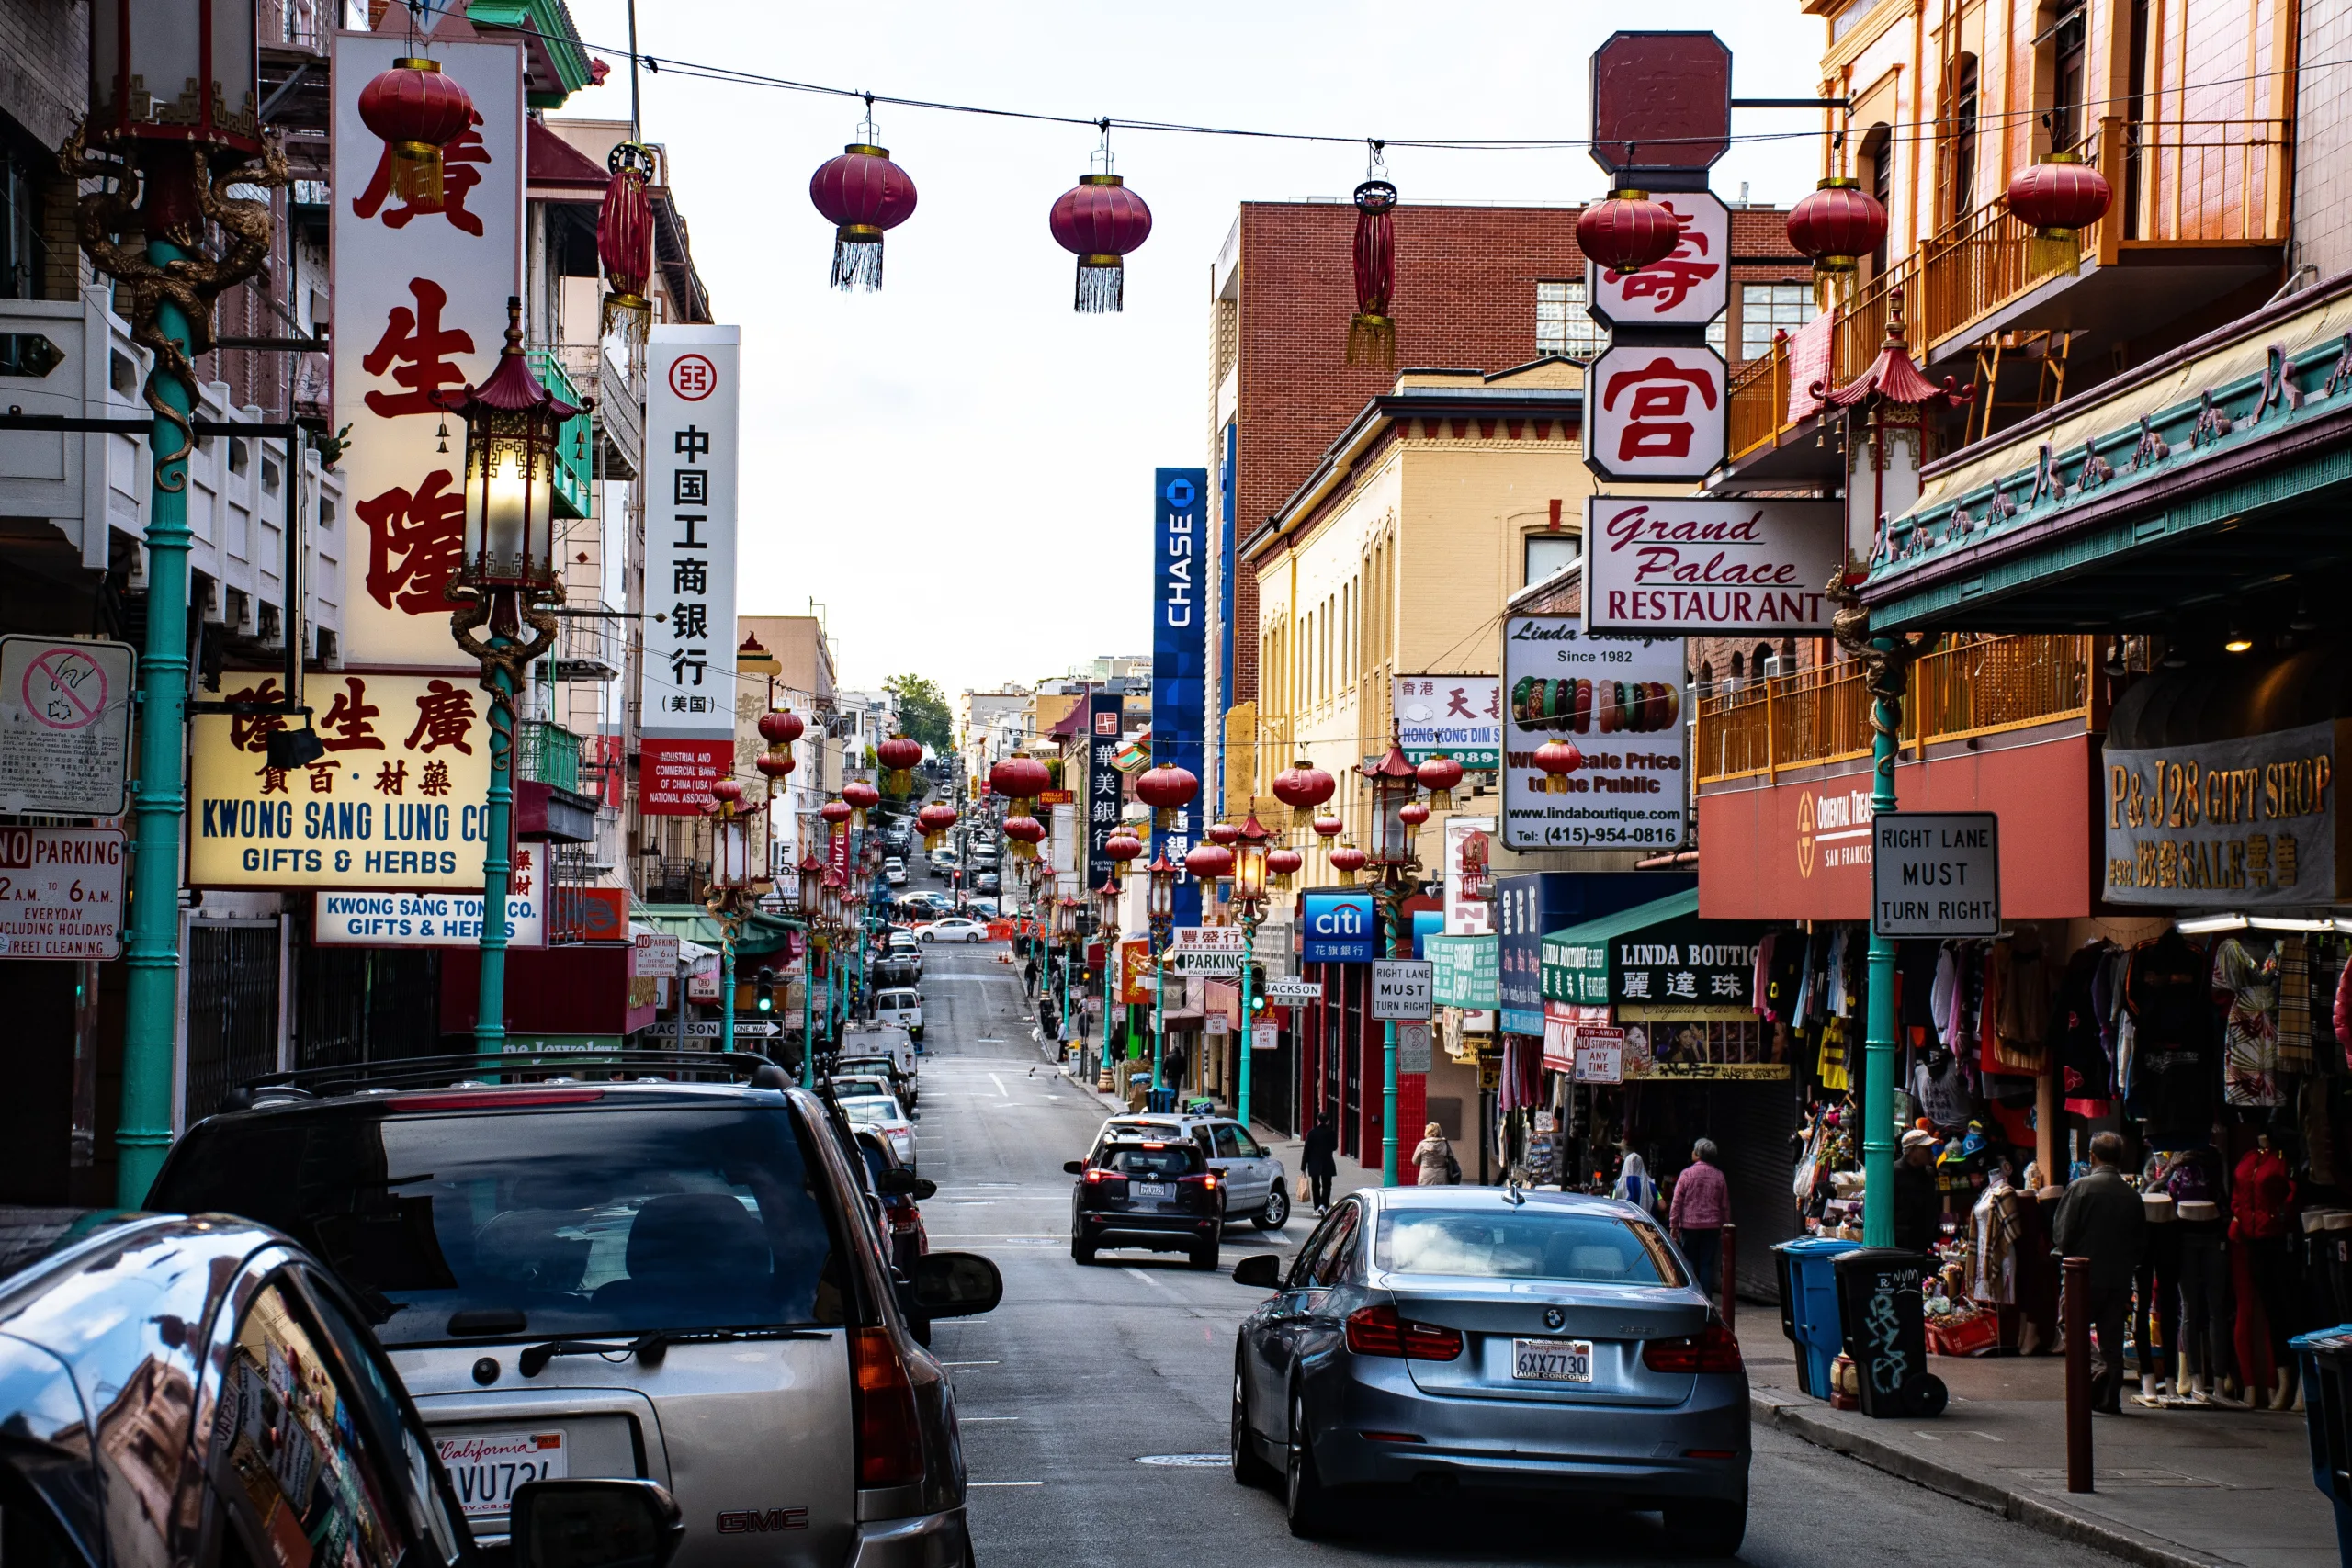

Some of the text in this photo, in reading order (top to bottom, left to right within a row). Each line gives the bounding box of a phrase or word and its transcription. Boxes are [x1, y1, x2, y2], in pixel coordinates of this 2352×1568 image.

[1607, 505, 1763, 552] Grand
[672, 424, 709, 686] 中国工商银行
[1168, 513, 1192, 626] CHASE
[1634, 547, 1796, 583] Palace
[1609, 591, 1826, 623] RESTAURANT
[1557, 650, 1632, 662] Since 1982
[1402, 682, 1433, 695] 香港
[1403, 728, 1490, 743] HONG KONG DIM
[660, 752, 711, 763] INDUSTRIAL AND
[1625, 753, 1681, 770] Price
[656, 765, 716, 776] COMMERCIAL BANK
[661, 780, 669, 788] OF
[673, 780, 692, 789] CHINA
[1593, 776, 1660, 794] Public
[2205, 768, 2259, 825] GIFT
[2266, 754, 2331, 819] SHOP
[650, 793, 680, 803] NATIONAL
[203, 799, 292, 839] KWONG
[305, 802, 371, 840] SANG
[385, 803, 449, 841] LUNG
[1509, 807, 1680, 821] www.lindaboutique.com
[1517, 827, 1676, 846] Tel: (415)-954-0816
[1882, 829, 1989, 848] RIGHT LANE
[36, 840, 119, 865] PARKING
[243, 848, 457, 874] GIFTS & HERBS
[1826, 847, 1838, 867] SAN
[2109, 857, 2132, 887] #932
[2180, 840, 2245, 889] SALE
[1904, 863, 1968, 885] MUST
[15, 889, 40, 901] A.M.
[70, 879, 83, 902] 6
[88, 891, 113, 903] A.M.
[25, 908, 83, 920] EVERYDAY
[327, 897, 394, 915] KWONG
[399, 899, 447, 916] SANG
[453, 901, 484, 917] TON
[508, 901, 536, 918] CO.
[1882, 901, 1991, 919] TURN RIGHT
[59, 924, 113, 936] HOLIDAYS
[347, 919, 515, 938] GIFTS & HERS
[1316, 908, 1362, 934] citi
[46, 942, 103, 953] CLEANING
[637, 936, 676, 947] NO PARKING
[1315, 945, 1363, 956] 花旗銀行
[1187, 954, 1244, 969] PARKING
[1543, 943, 1559, 964] LINDA
[1560, 946, 1587, 969] BOUTIQUE
[1621, 944, 1680, 965] LINDA
[1376, 969, 1430, 979] RIGHT LANE
[1265, 985, 1318, 994] JACKSON
[1381, 985, 1425, 996] MUST
[1376, 1001, 1430, 1011] TURN RIGHT
[647, 1024, 717, 1034] JACSON
[1577, 1036, 1621, 1050] NO STOPPING
[1589, 1052, 1608, 1061] ANY
[1589, 1063, 1609, 1072] TIME
[1519, 1353, 1586, 1374] 6XXZ730
[441, 1439, 537, 1461] California
[717, 1507, 808, 1534] GMC
